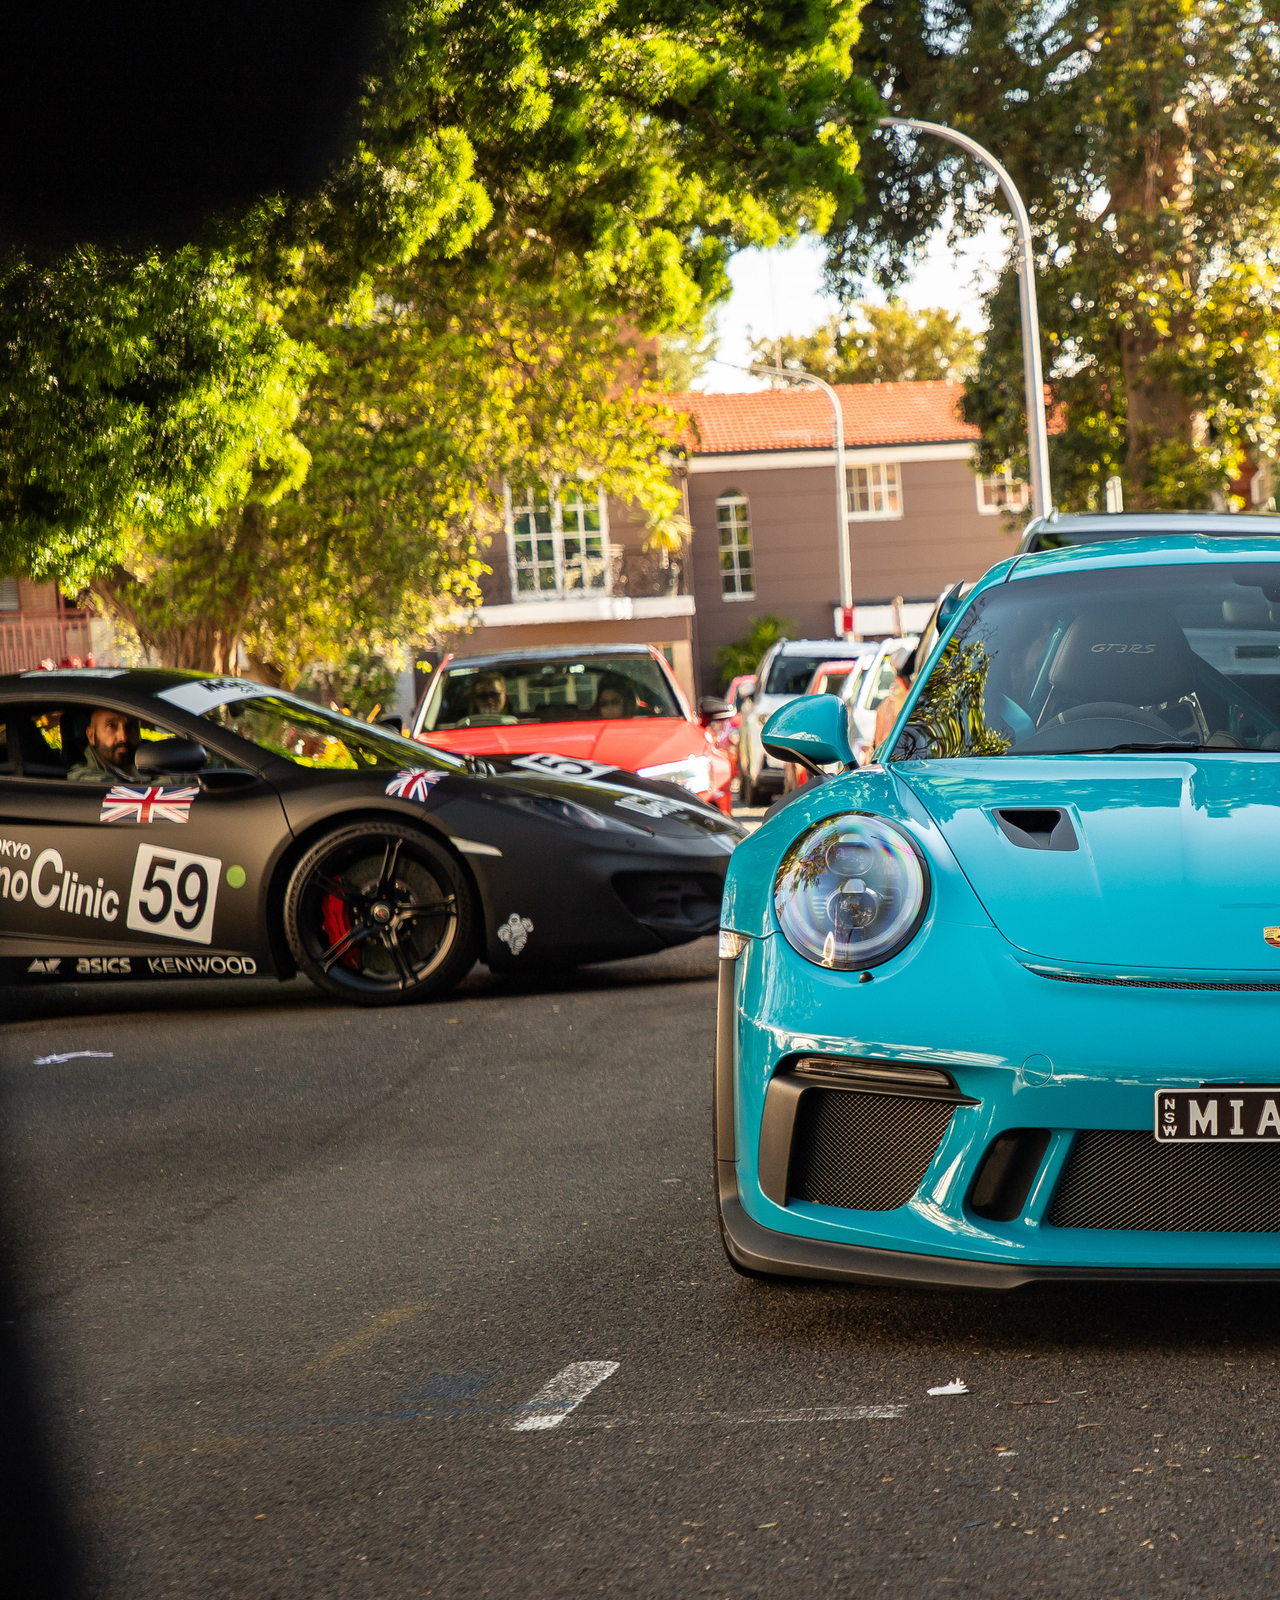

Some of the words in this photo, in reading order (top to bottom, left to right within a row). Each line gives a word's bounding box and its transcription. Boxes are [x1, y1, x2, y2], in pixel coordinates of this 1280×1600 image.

[138, 855, 209, 930] 59
[76, 957, 132, 974] asics
[147, 956, 257, 975] KENWOOD
